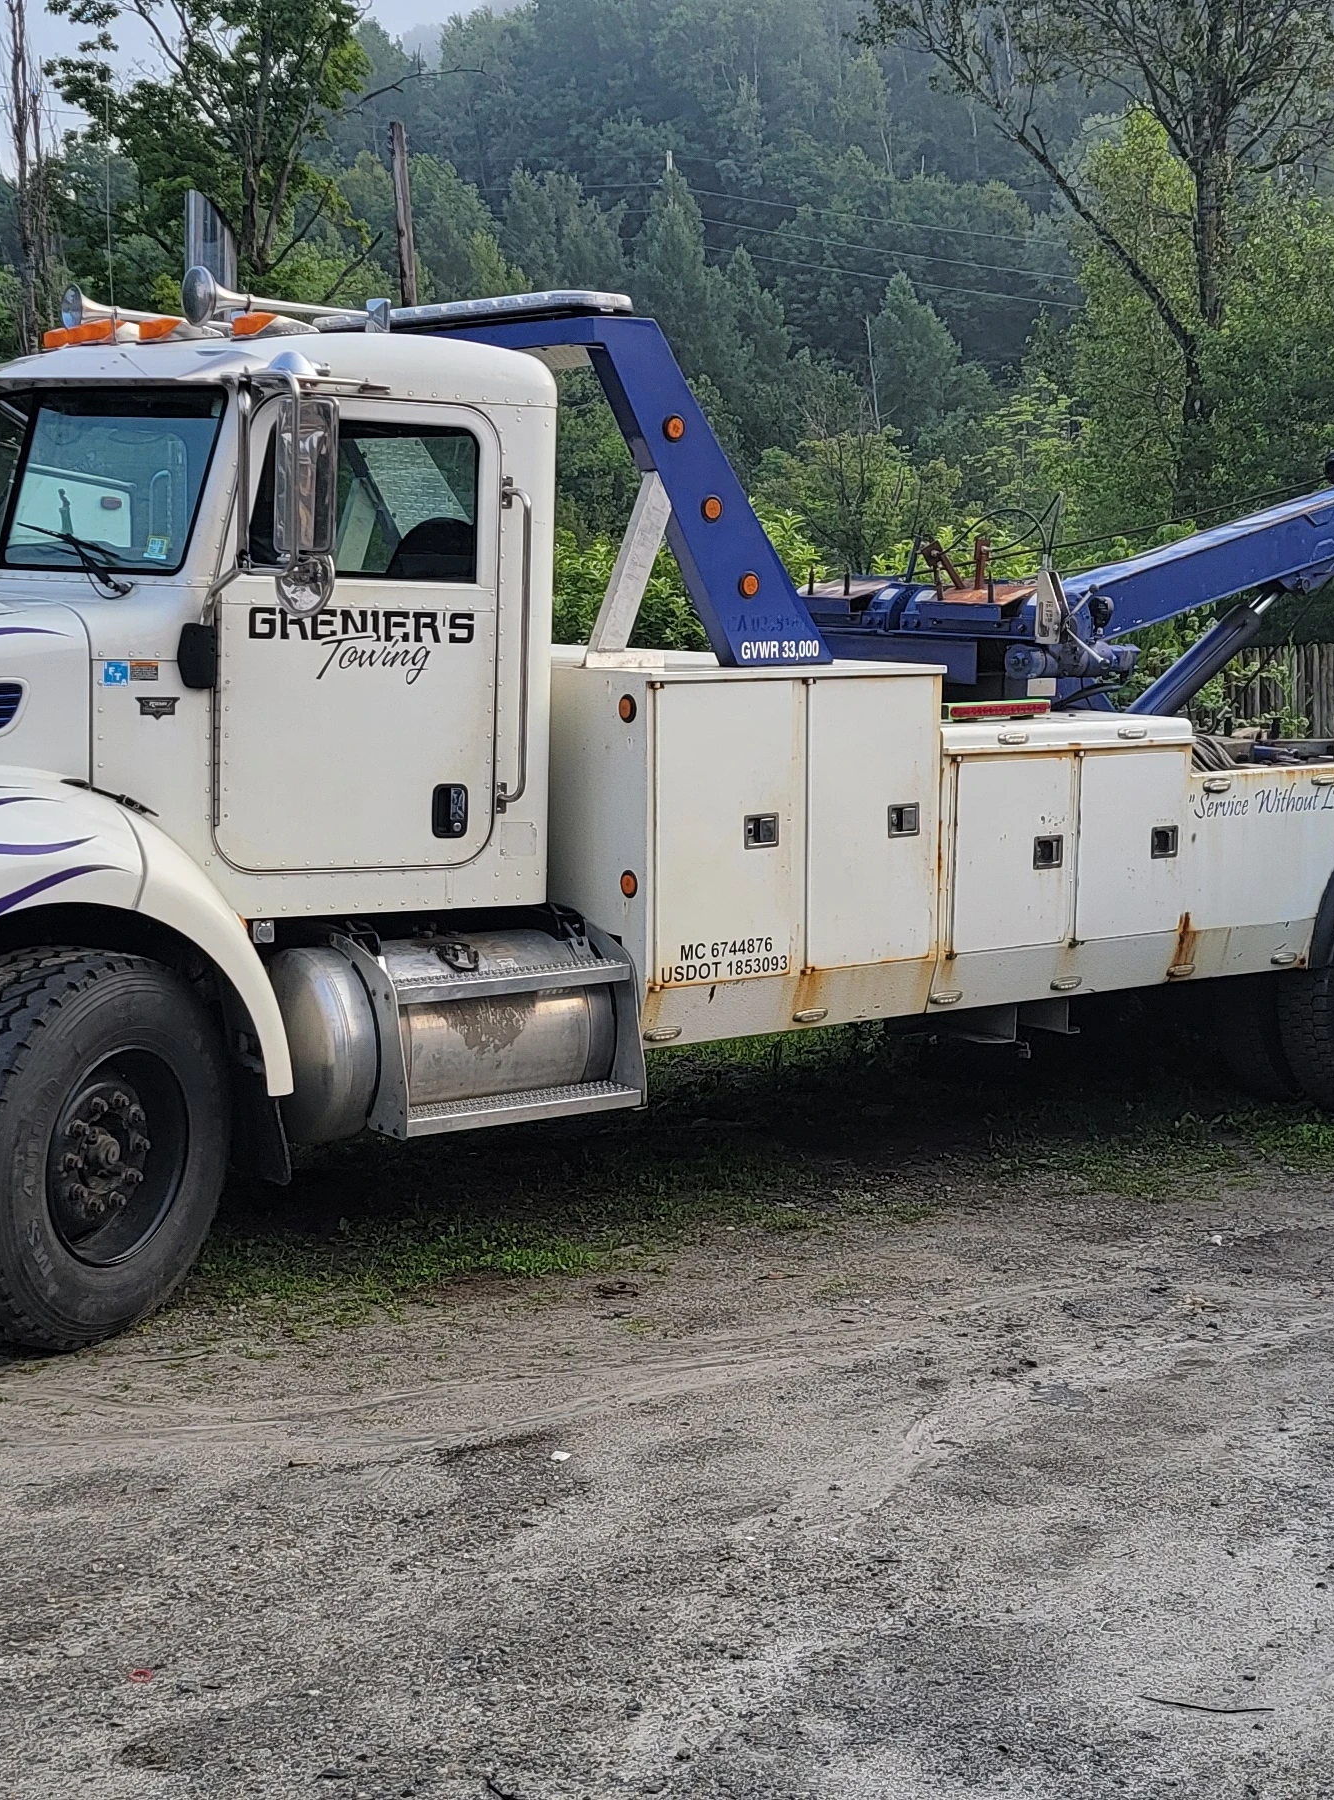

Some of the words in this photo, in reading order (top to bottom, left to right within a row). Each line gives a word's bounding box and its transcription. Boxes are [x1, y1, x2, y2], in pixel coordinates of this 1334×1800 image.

[249, 607, 474, 643] GRENIER'S
[316, 635, 431, 685] Towing
[741, 641, 779, 659] GVWR
[782, 640, 819, 660] 33,000
[1255, 782, 1318, 814] Without
[680, 943, 706, 961] MC
[711, 937, 773, 958] 6744876
[661, 962, 722, 984] USDOT
[726, 955, 788, 976] 1853093
